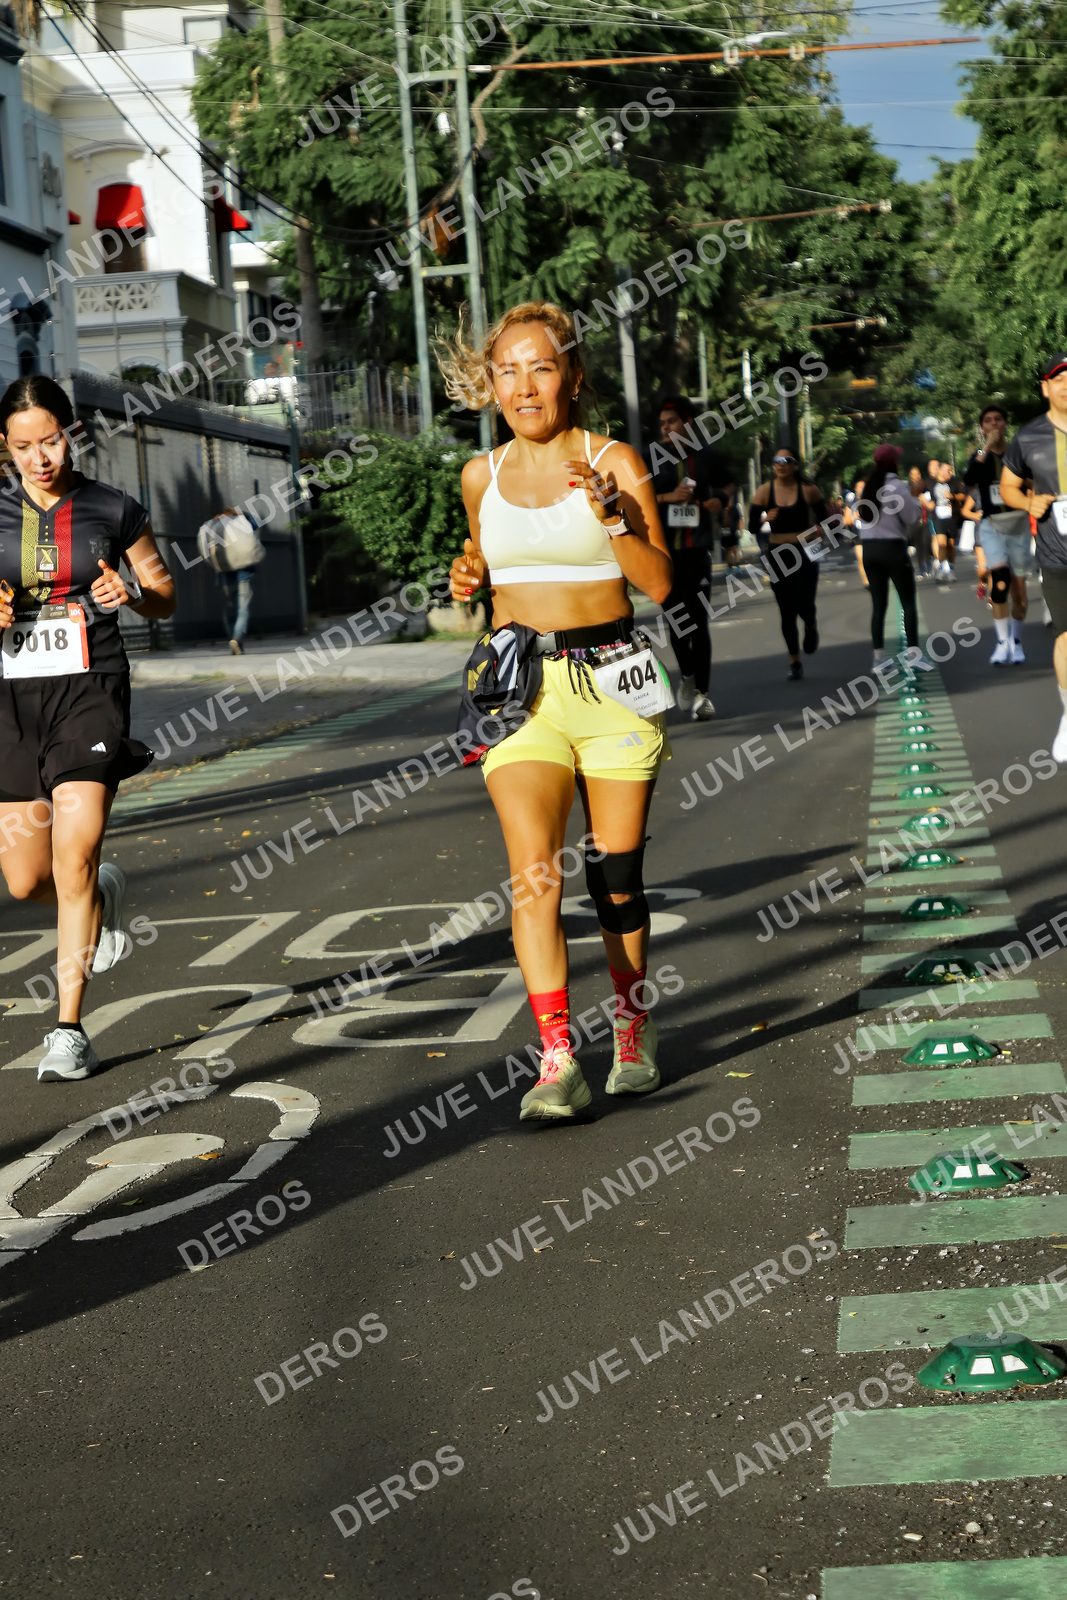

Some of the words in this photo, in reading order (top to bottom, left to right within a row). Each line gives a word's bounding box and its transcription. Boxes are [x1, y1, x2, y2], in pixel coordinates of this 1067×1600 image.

[673, 507, 696, 517] 9100
[13, 628, 68, 653] 9018
[617, 660, 657, 694] 404
